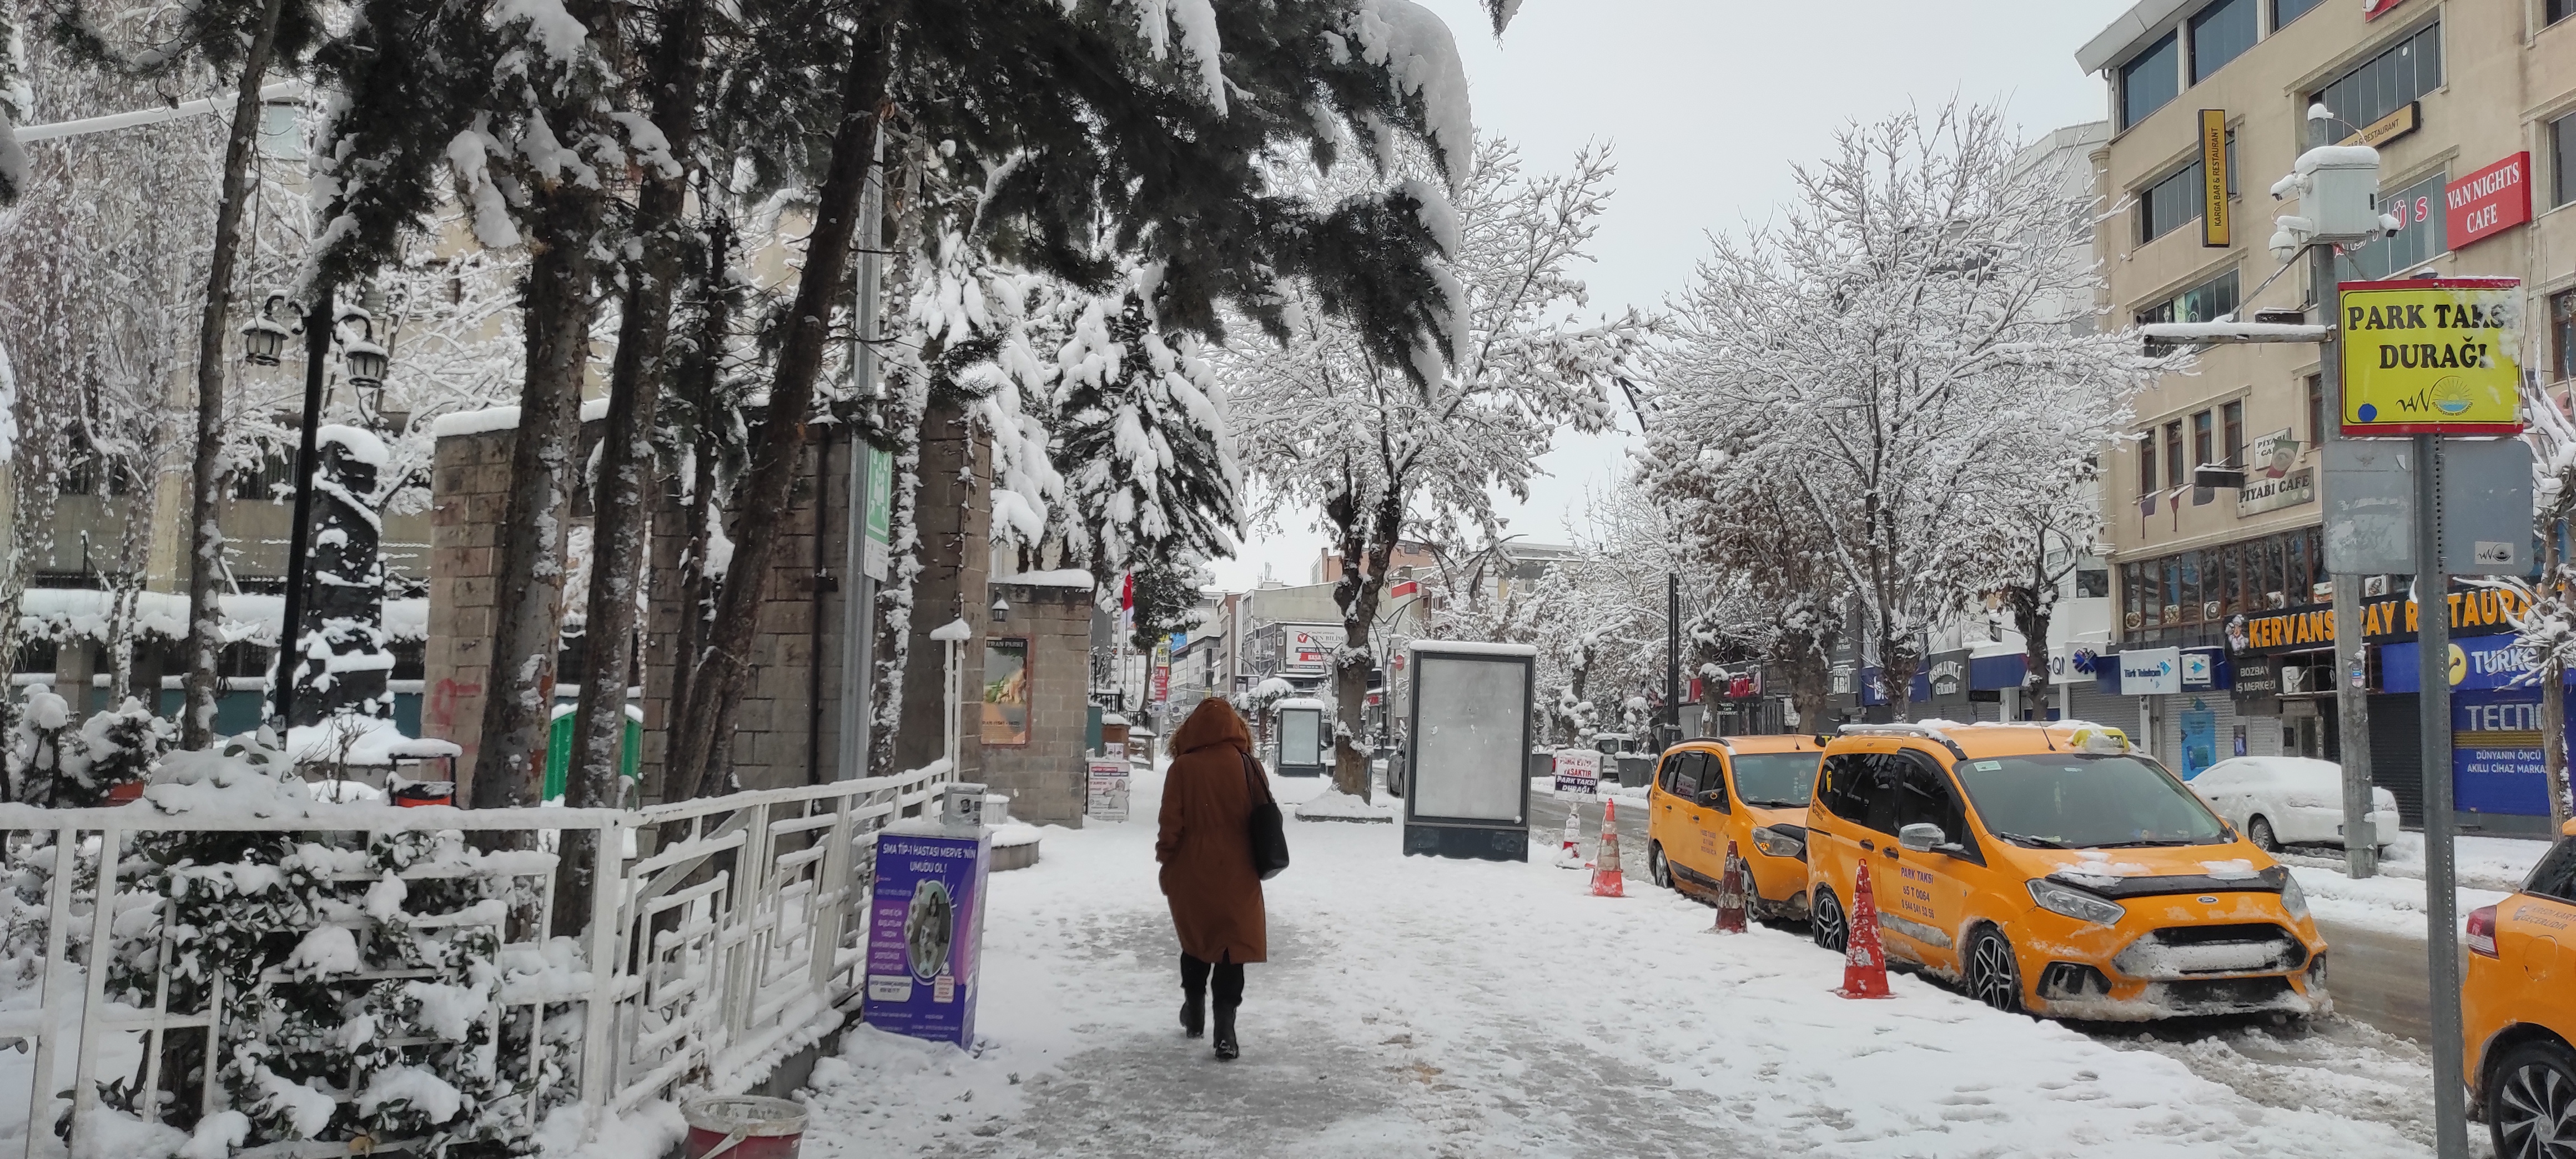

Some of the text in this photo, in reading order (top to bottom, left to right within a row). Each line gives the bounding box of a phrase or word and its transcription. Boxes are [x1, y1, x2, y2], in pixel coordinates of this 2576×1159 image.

[2363, 118, 2399, 143] RESTAURANT
[2211, 127, 2220, 176] RESTAURANT
[2213, 185, 2221, 200] BAR
[2447, 161, 2520, 211] VAN NIGHTS
[2466, 203, 2499, 234] CAFE
[2347, 304, 2505, 331] PARK TAKS
[2379, 335, 2488, 369] DURAĞI
[2261, 448, 2272, 457] CA
[2238, 475, 2310, 503] PİYABİ CAFE
[2249, 601, 2396, 648] KERVANSAY
[2240, 666, 2270, 677] BOZBAY
[2476, 749, 2515, 760] DÜNYANIN
[1563, 768, 1592, 777] YASAKTIR
[2467, 763, 2547, 774] AKILLI CİHAZ MARKA
[1557, 775, 1576, 785] PARK
[1901, 867, 1915, 880] PARK
[1911, 887, 1914, 897] T
